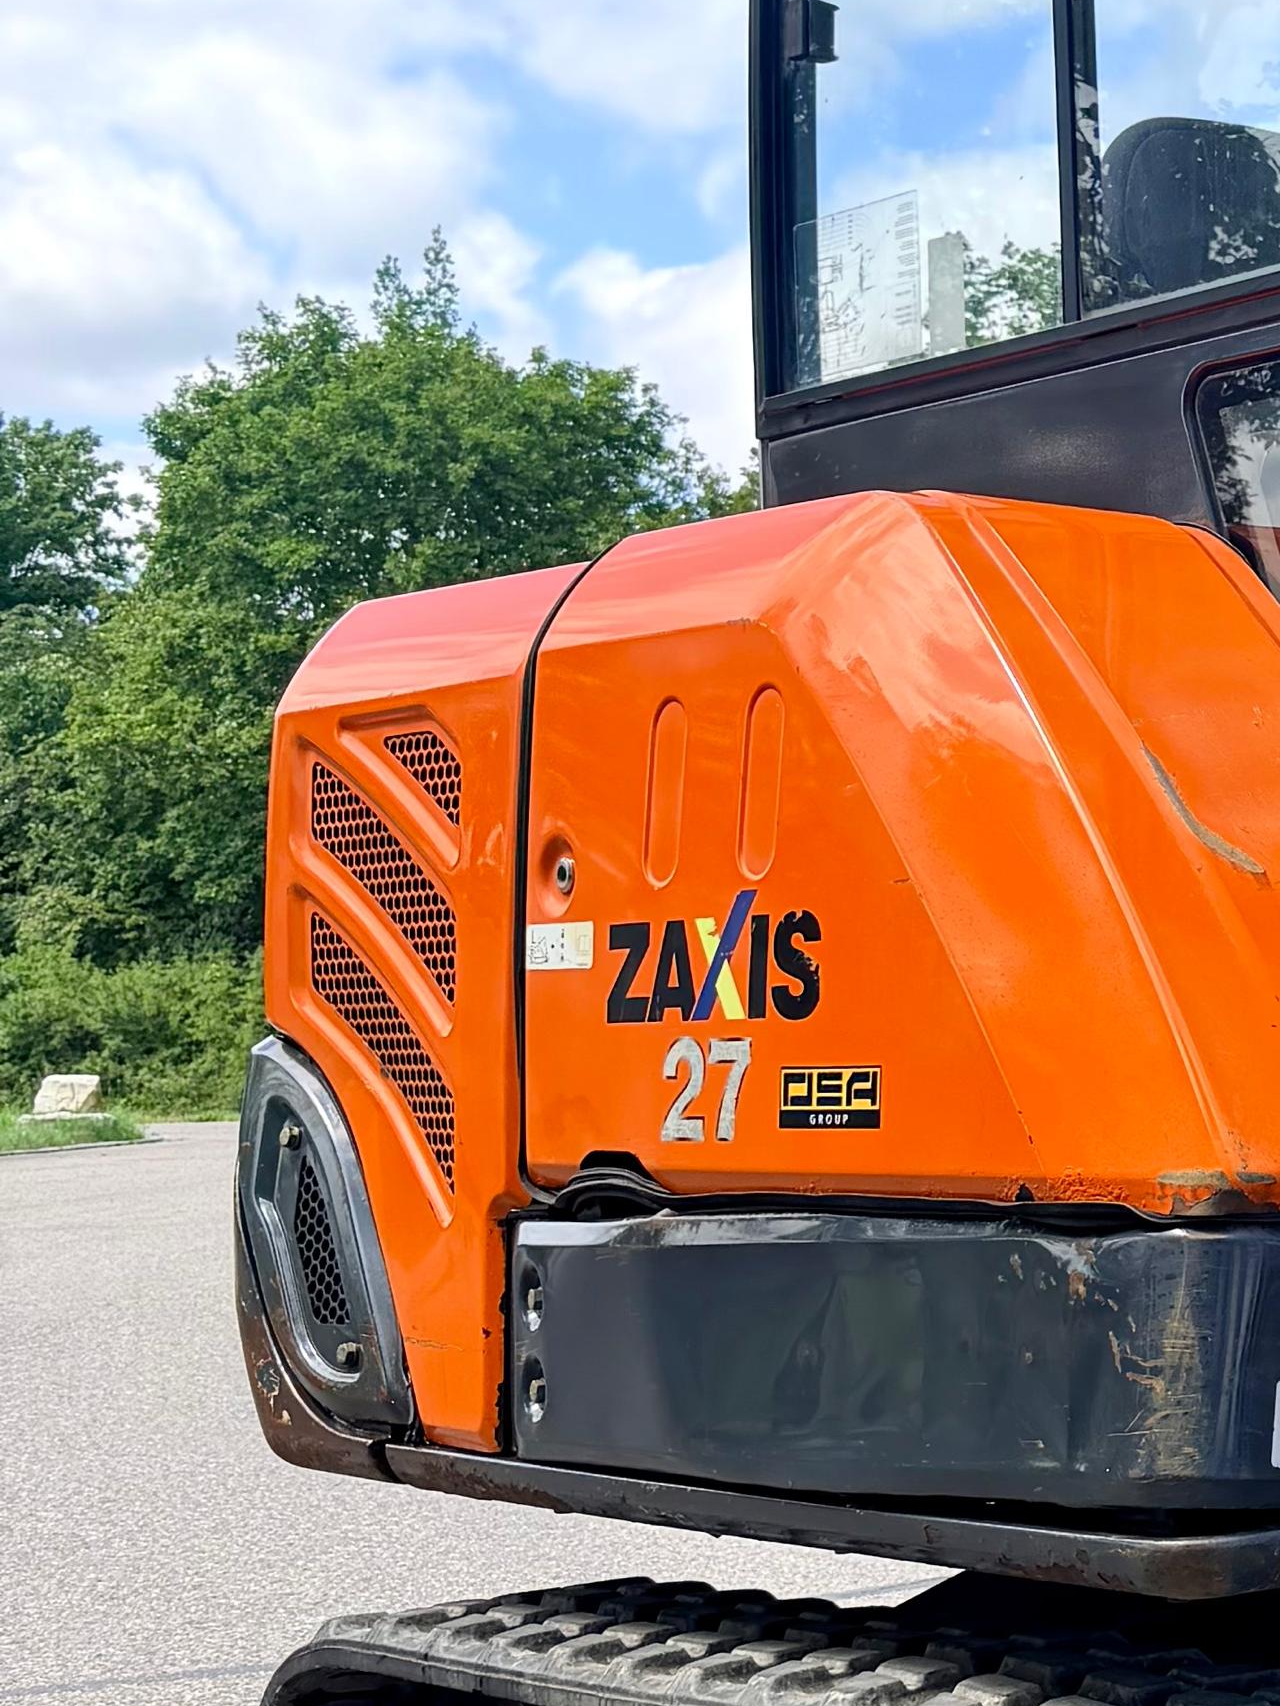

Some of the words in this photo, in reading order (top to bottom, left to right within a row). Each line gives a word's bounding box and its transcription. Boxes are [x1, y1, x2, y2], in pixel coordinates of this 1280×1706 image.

[606, 889, 823, 1024] ZAXIS
[661, 1036, 752, 1142] 27
[809, 1114, 849, 1125] GROUP
